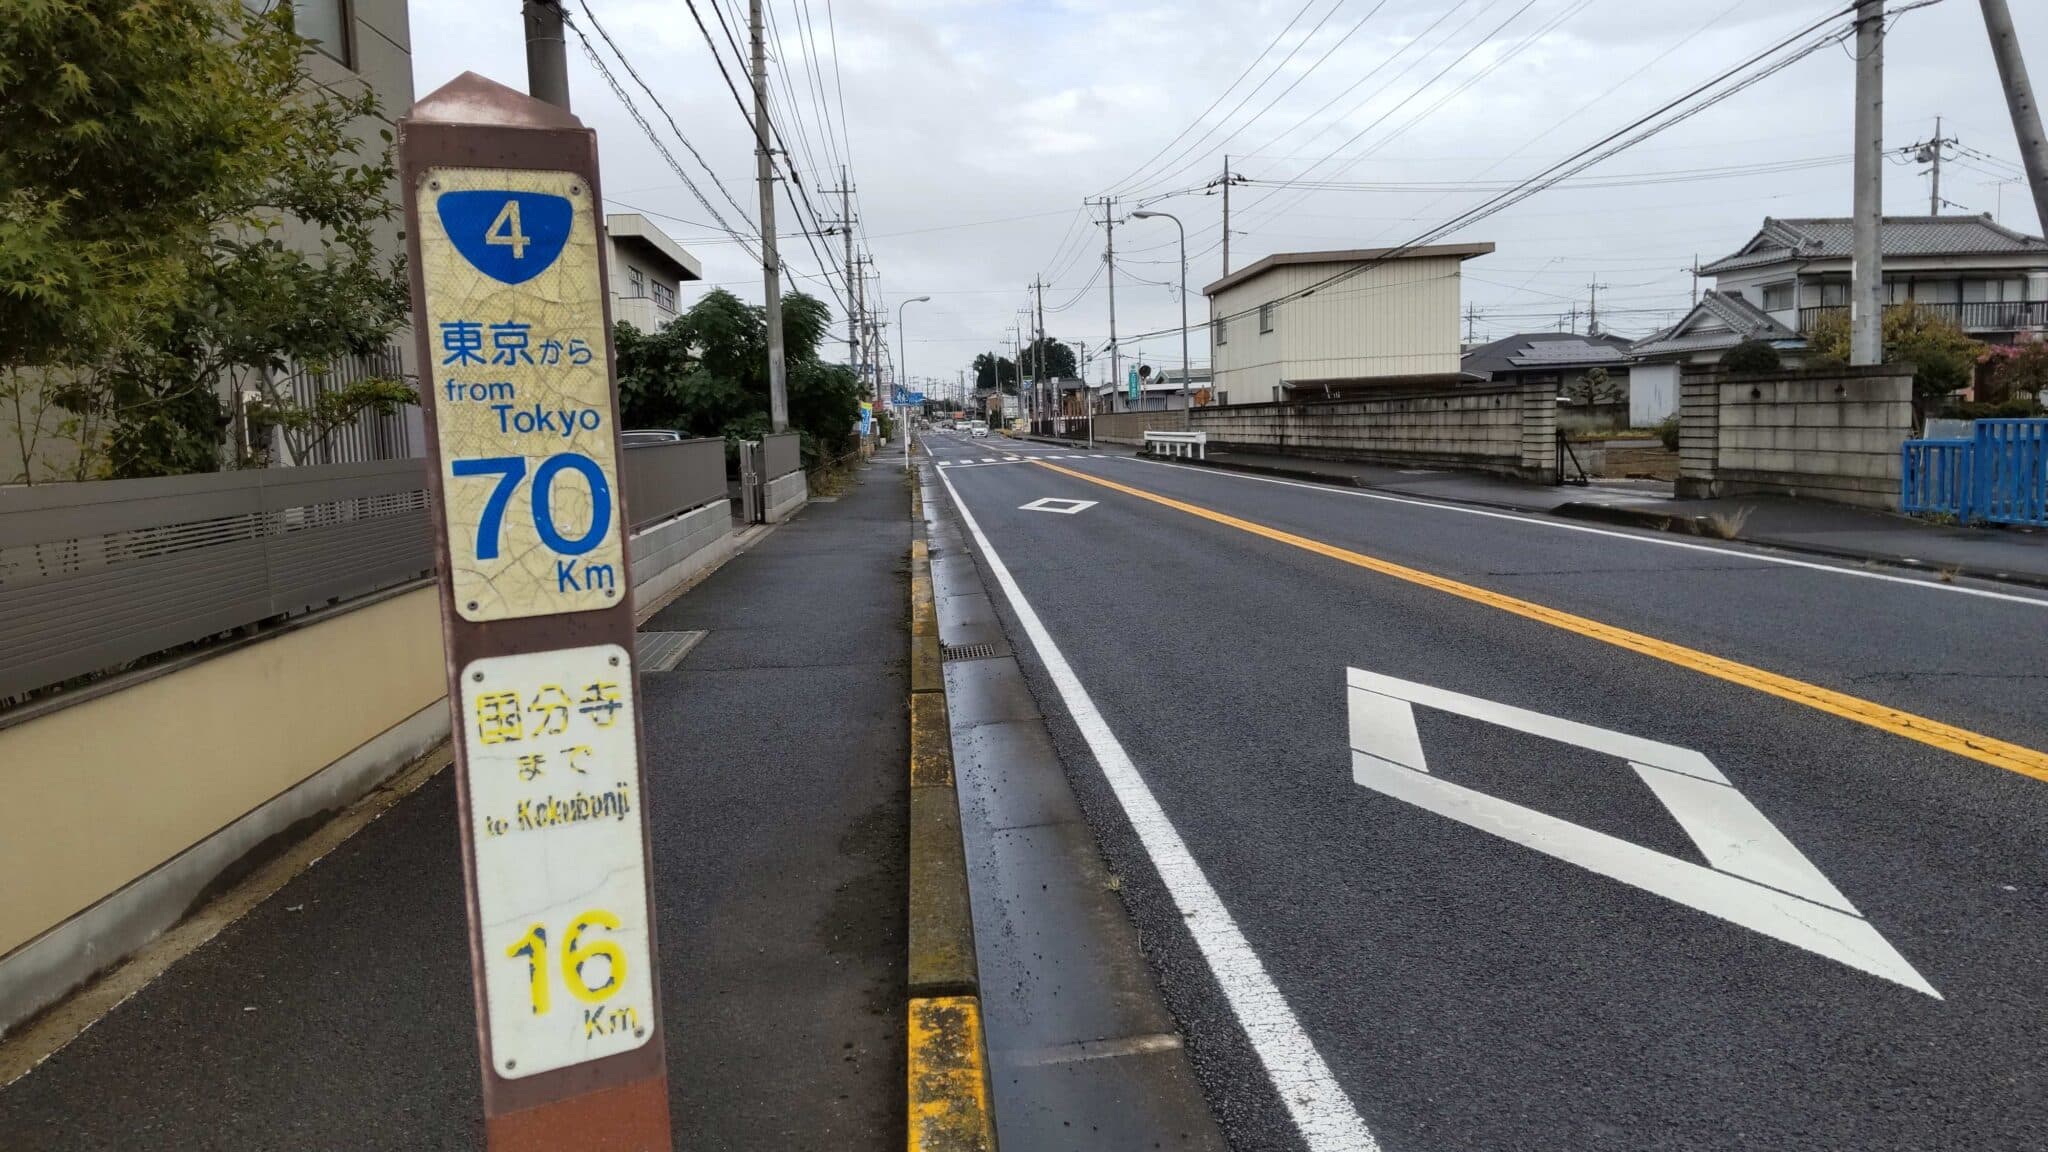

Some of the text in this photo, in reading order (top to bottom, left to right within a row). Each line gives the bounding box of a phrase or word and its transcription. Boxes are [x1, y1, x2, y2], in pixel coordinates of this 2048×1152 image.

[485, 200, 531, 259] 4
[439, 321, 592, 367] 東京から
[446, 379, 515, 402] from
[492, 404, 601, 437] Tokyo
[452, 453, 612, 560] 70
[557, 560, 614, 593] Km
[517, 746, 594, 780] まで
[485, 782, 631, 837] to Kokubunji
[506, 909, 627, 1016] 16
[584, 1005, 637, 1040] Km
